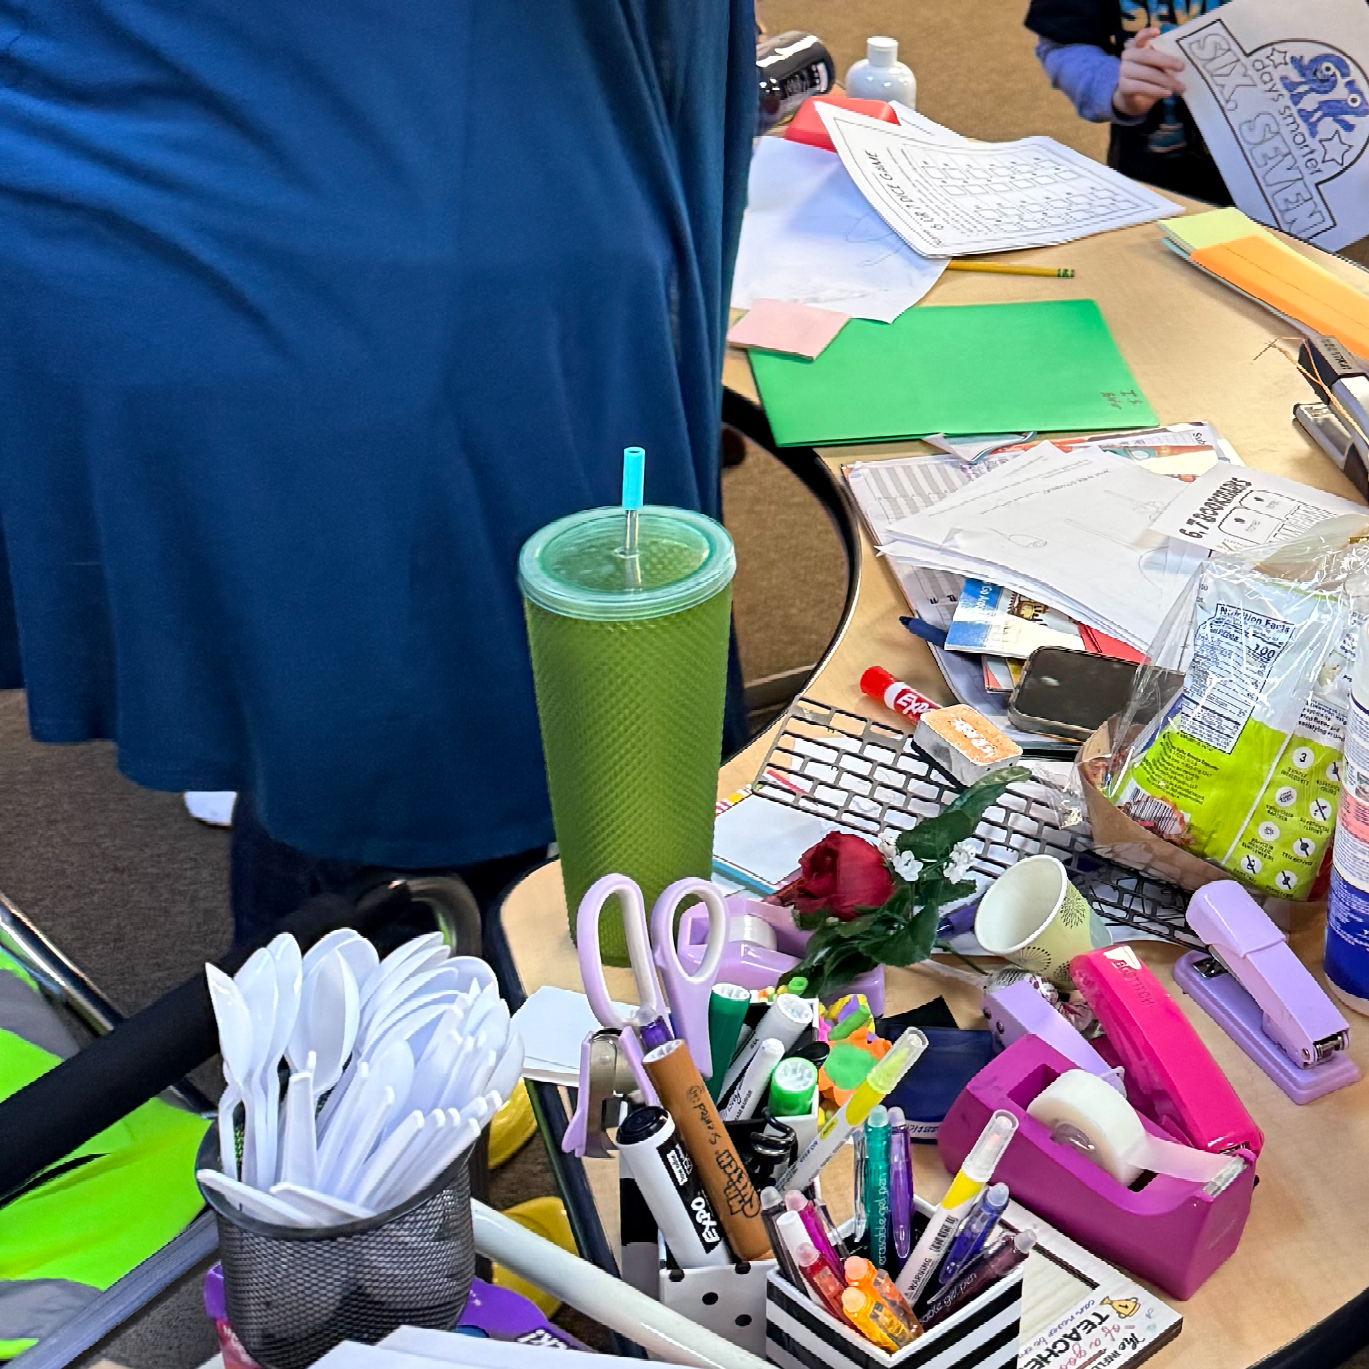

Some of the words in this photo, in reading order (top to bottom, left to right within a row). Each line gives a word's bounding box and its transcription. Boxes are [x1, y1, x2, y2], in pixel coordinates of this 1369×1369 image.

[1251, 57, 1284, 103] days
[1278, 104, 1324, 177] smarter
[1239, 111, 1328, 243] SEVEN
[1299, 752, 1307, 763] 3
[690, 1196, 721, 1243] EXPO
[908, 1257, 932, 1292] WARNING
[959, 1272, 978, 1294] pen
[1018, 1311, 1111, 1369] TEACHE
